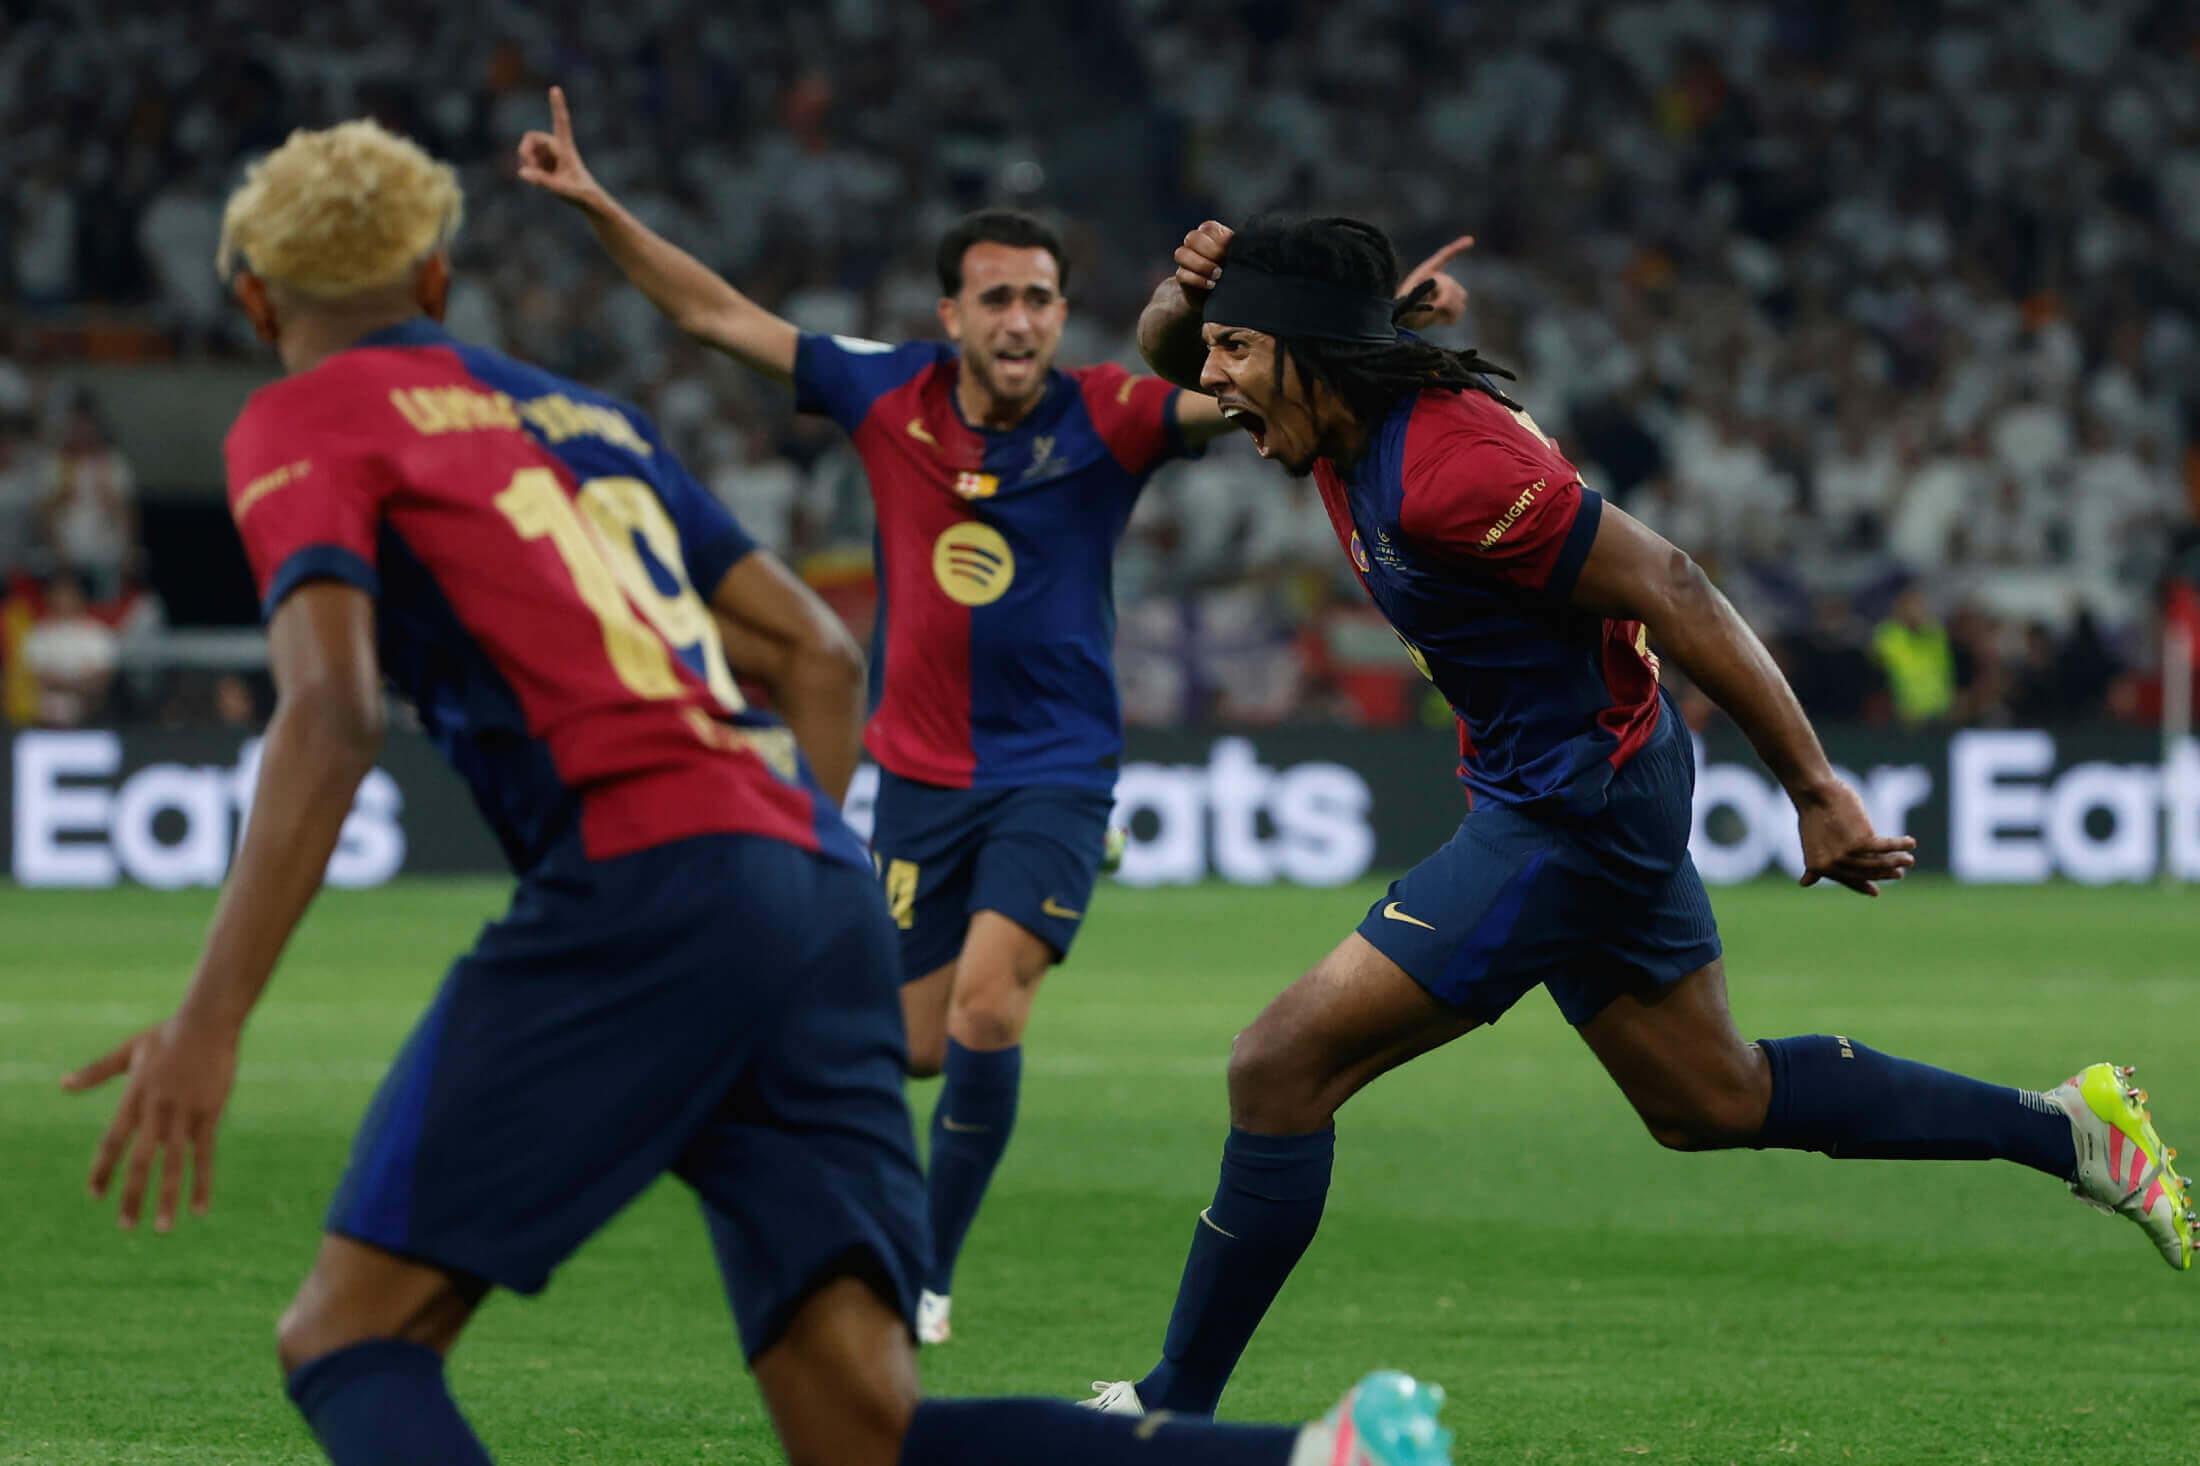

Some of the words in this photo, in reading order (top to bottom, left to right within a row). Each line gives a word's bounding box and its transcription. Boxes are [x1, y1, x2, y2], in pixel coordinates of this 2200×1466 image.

[494, 467, 747, 714] 19
[1477, 487, 1537, 551] MBILIGHT
[1107, 736, 1376, 888] ats
